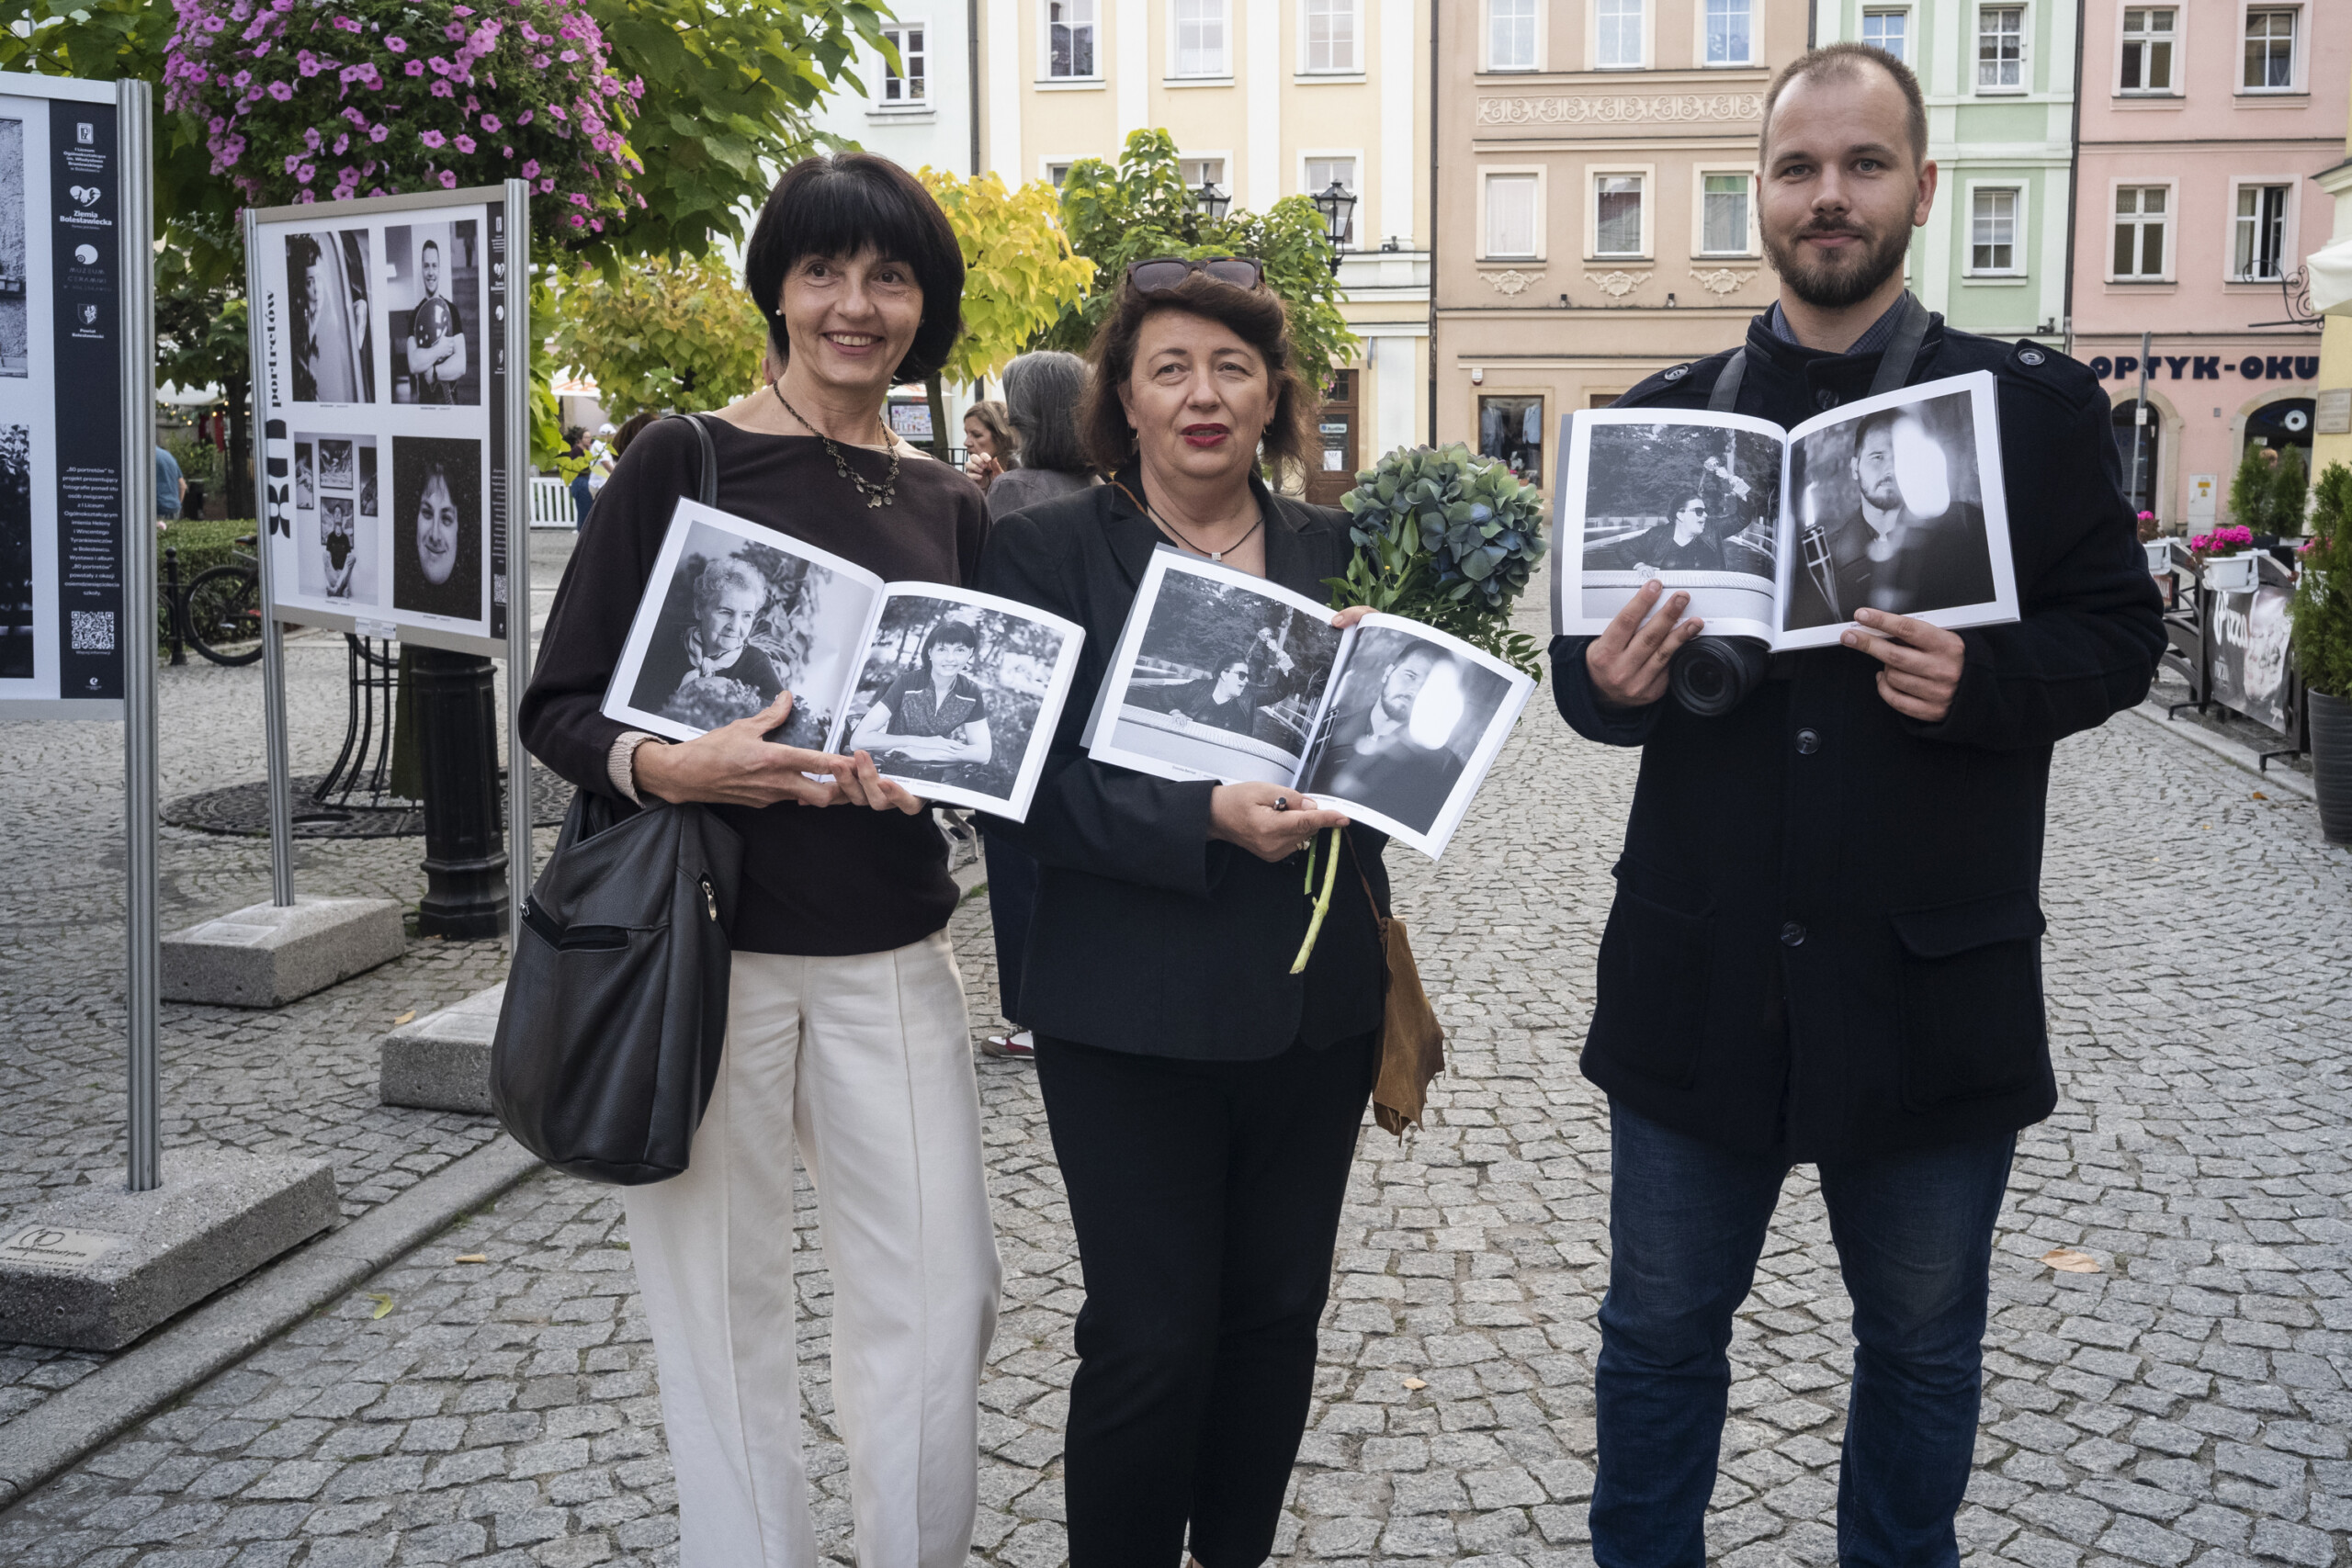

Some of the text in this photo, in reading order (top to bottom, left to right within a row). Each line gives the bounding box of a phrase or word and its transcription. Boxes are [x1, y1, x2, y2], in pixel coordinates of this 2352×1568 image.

[74, 210, 98, 218] Ziemia
[60, 215, 112, 226] Bolesławiecka
[266, 289, 282, 407] portretów
